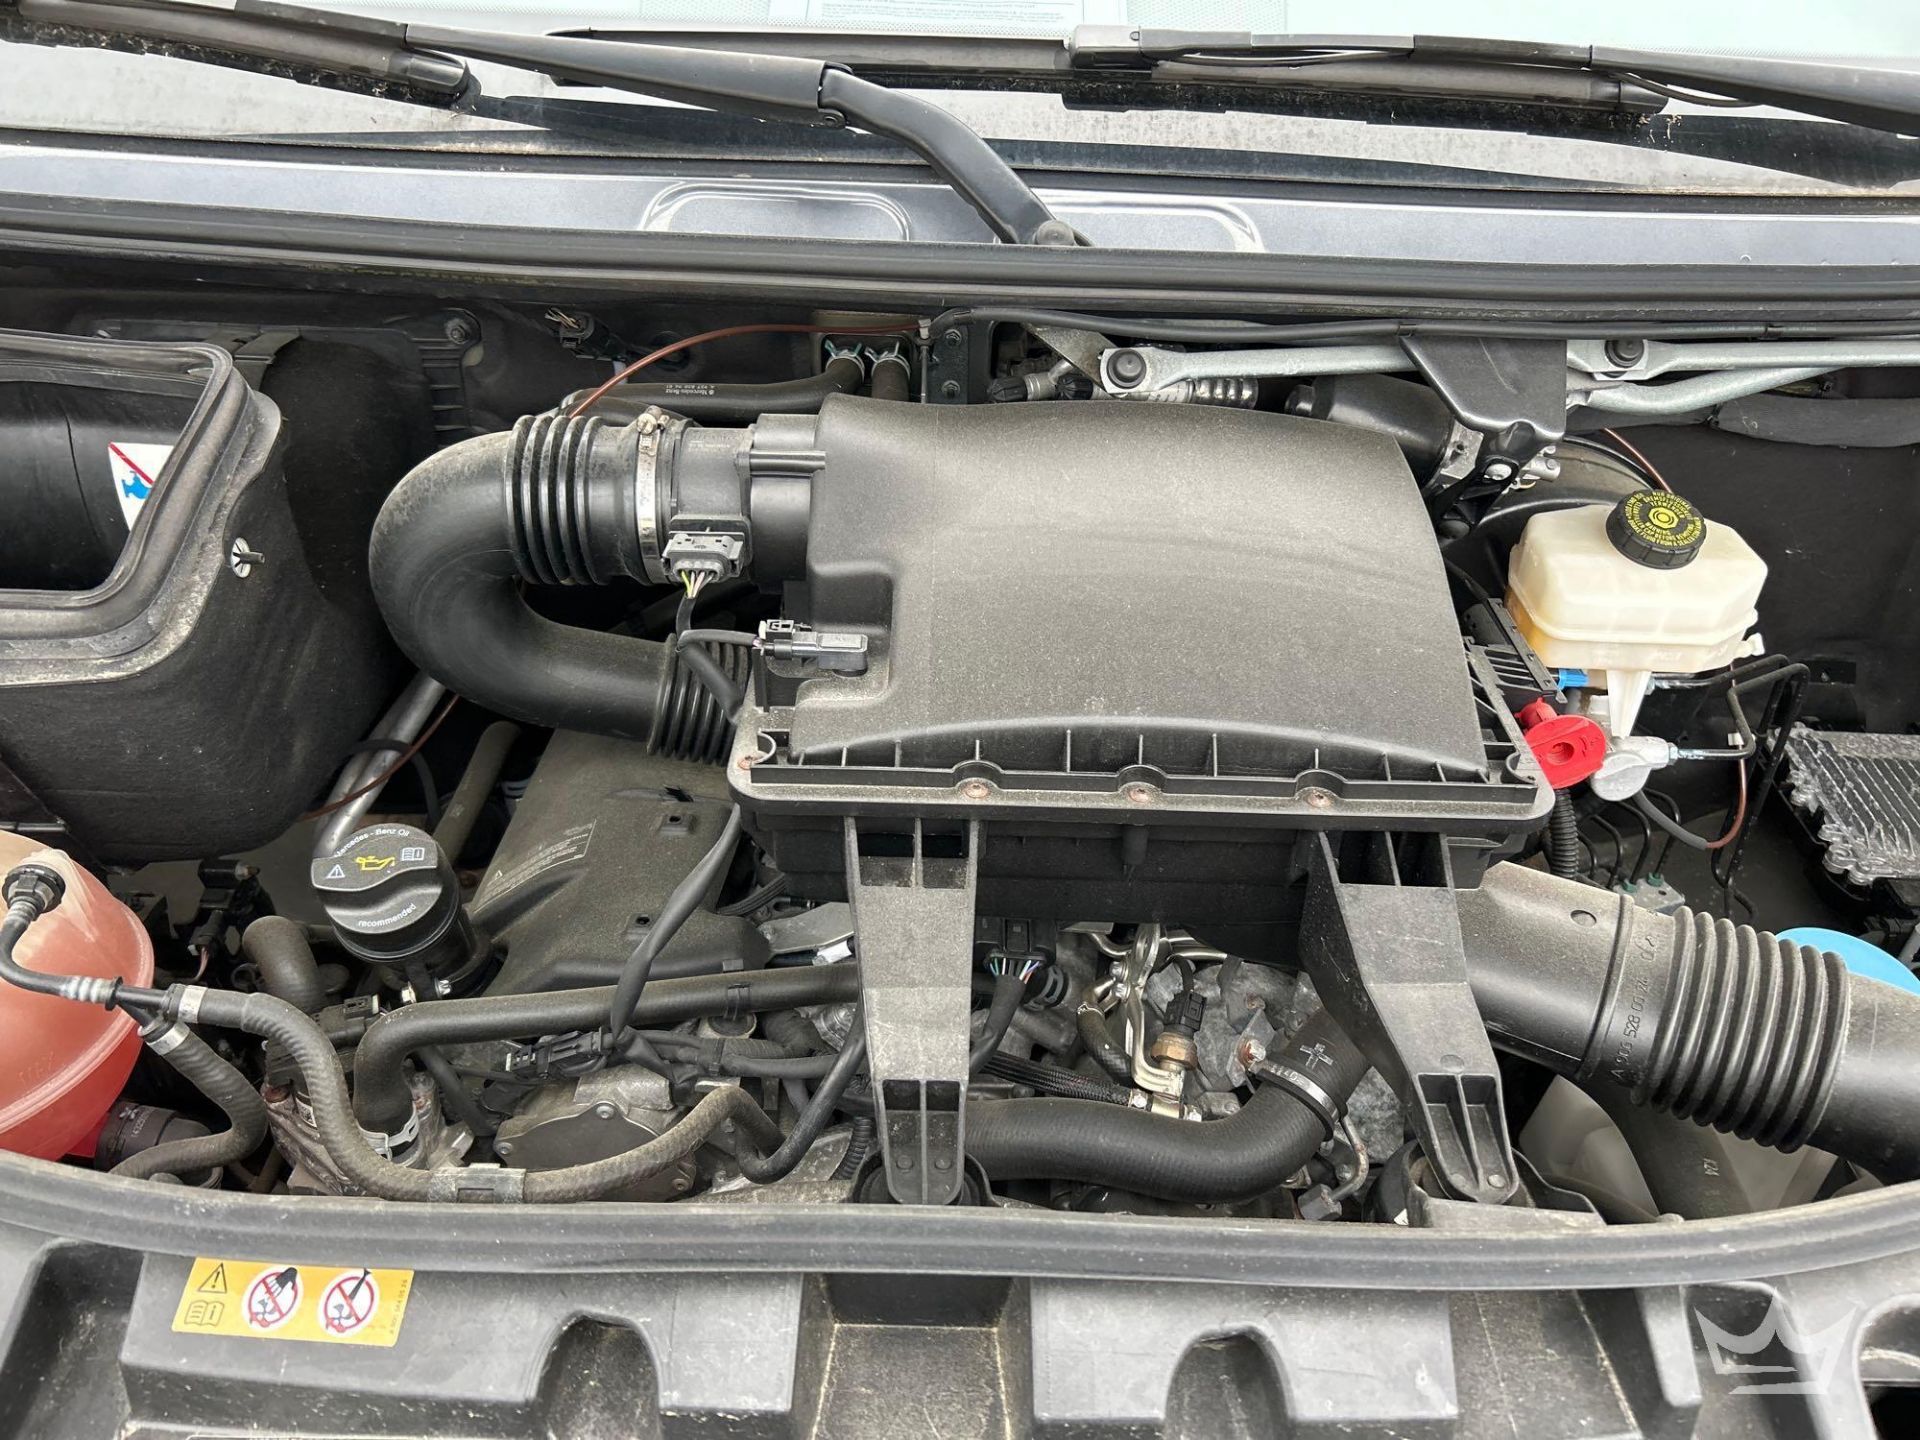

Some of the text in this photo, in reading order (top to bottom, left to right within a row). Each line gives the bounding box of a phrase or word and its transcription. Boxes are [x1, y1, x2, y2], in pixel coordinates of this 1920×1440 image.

[1666, 493, 1692, 510] ORIGINAL
[358, 902, 417, 928] recommended
[1623, 1013, 1642, 1039] 528
